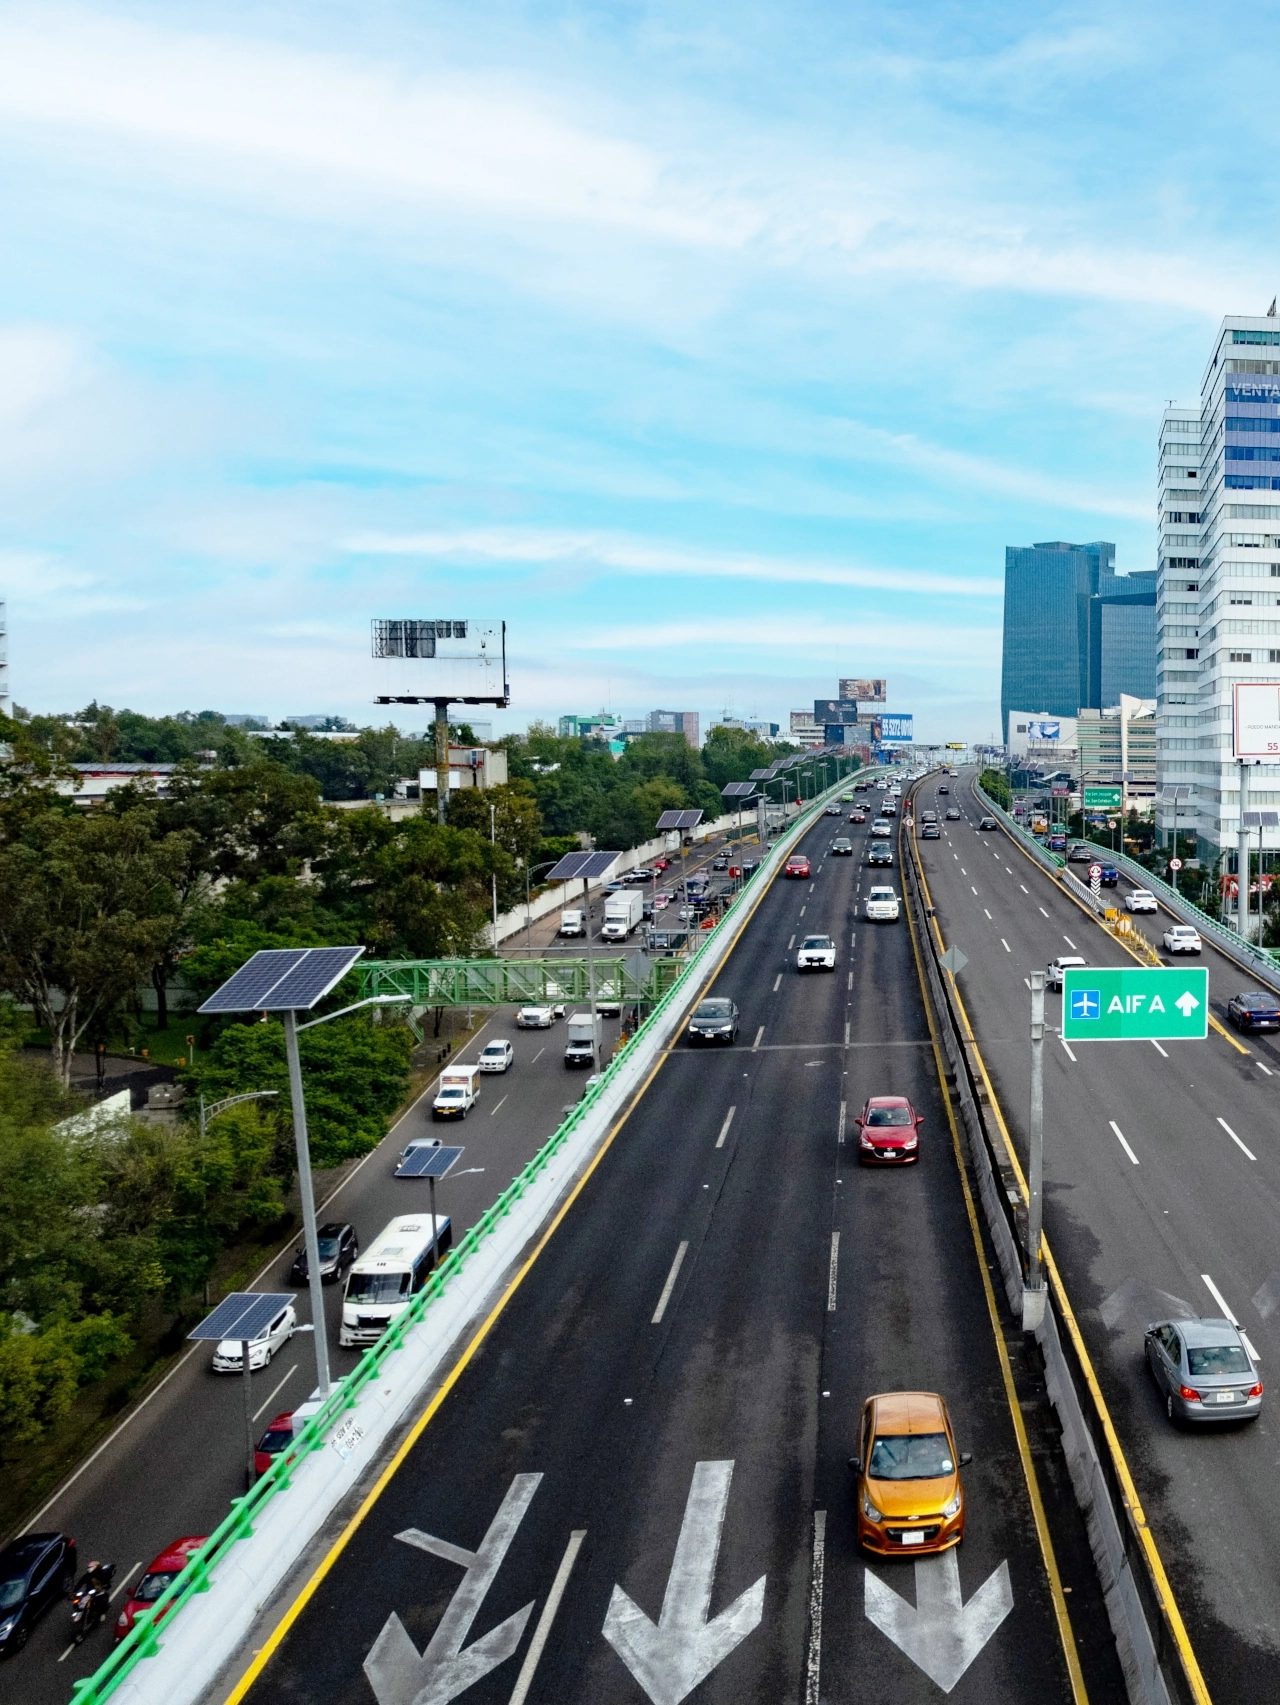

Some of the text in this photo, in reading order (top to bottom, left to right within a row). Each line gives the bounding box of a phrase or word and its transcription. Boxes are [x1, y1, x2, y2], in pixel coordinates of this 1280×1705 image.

[1232, 382, 1280, 397] VENTA
[1267, 742, 1278, 751] 55
[1107, 994, 1166, 1014] AIFA
